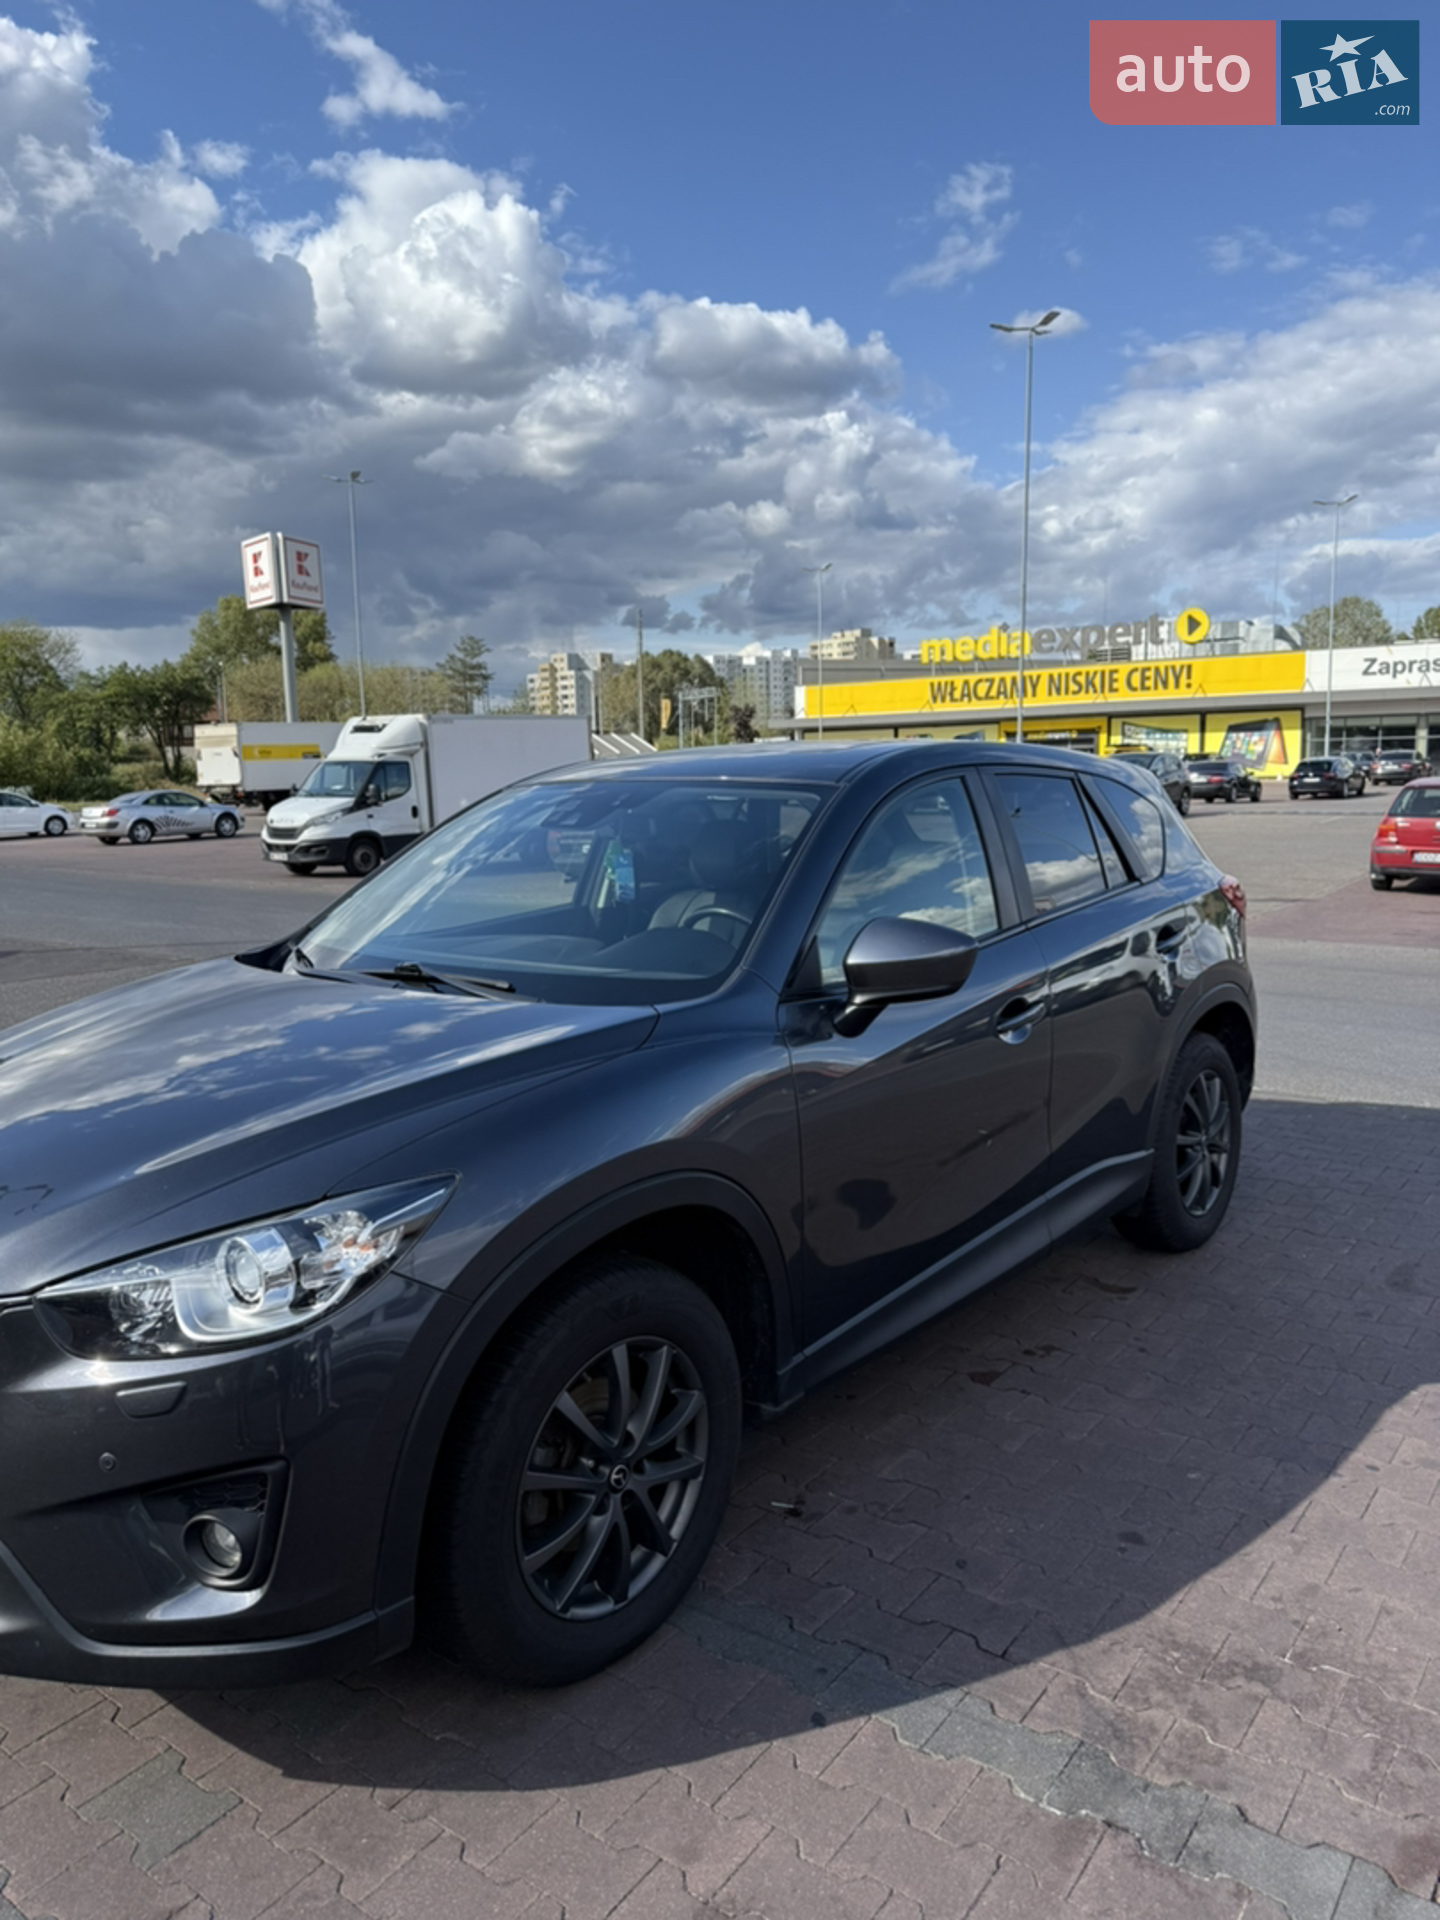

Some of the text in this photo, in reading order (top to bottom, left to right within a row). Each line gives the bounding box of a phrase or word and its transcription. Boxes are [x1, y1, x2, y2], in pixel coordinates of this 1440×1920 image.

[920, 613, 1166, 665] mediaexpert
[929, 664, 1193, 705] WŁĄCZAMY NISKIE CENY!
